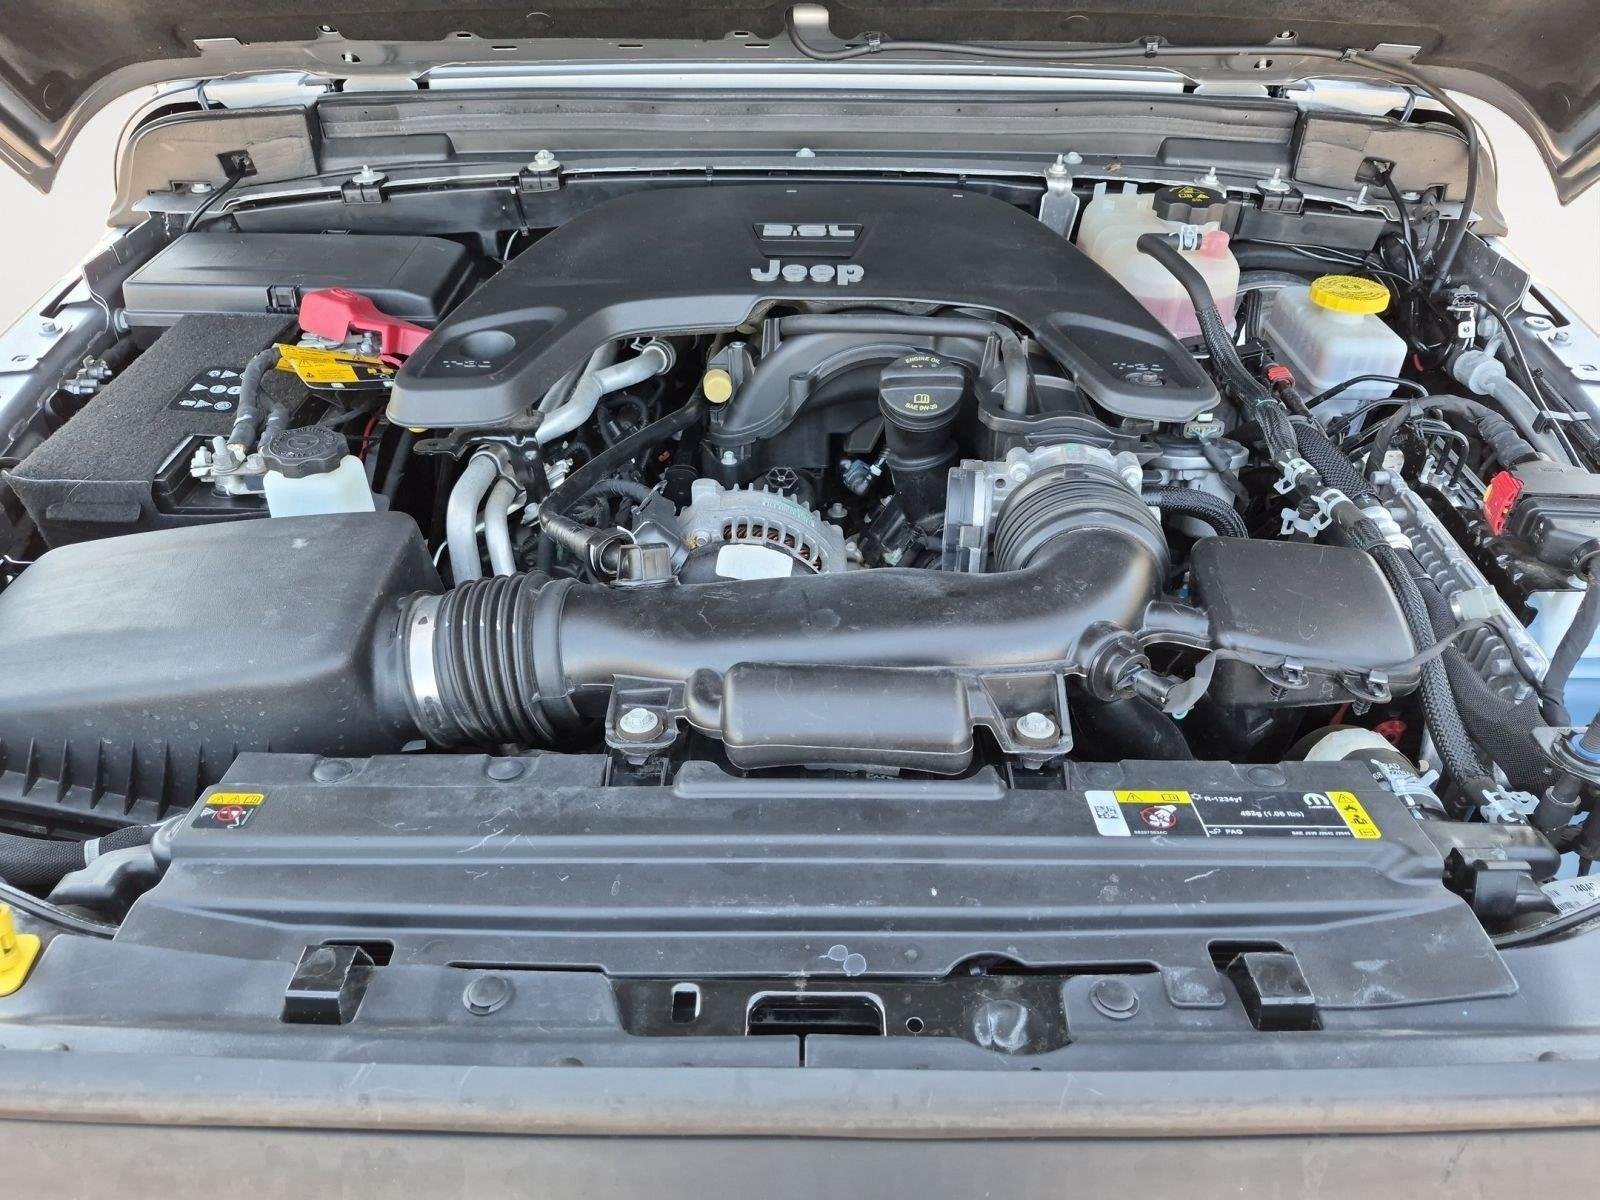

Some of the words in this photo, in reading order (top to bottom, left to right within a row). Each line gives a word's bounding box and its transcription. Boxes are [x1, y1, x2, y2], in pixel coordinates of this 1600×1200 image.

[750, 259, 865, 286] Jeep
[905, 356, 930, 364] ENGINE
[930, 357, 941, 365] OIL
[905, 402, 919, 411] SAE
[919, 403, 938, 411] 0W-20
[1204, 796, 1243, 804] R-1234yf
[1286, 810, 1305, 818] lbs)
